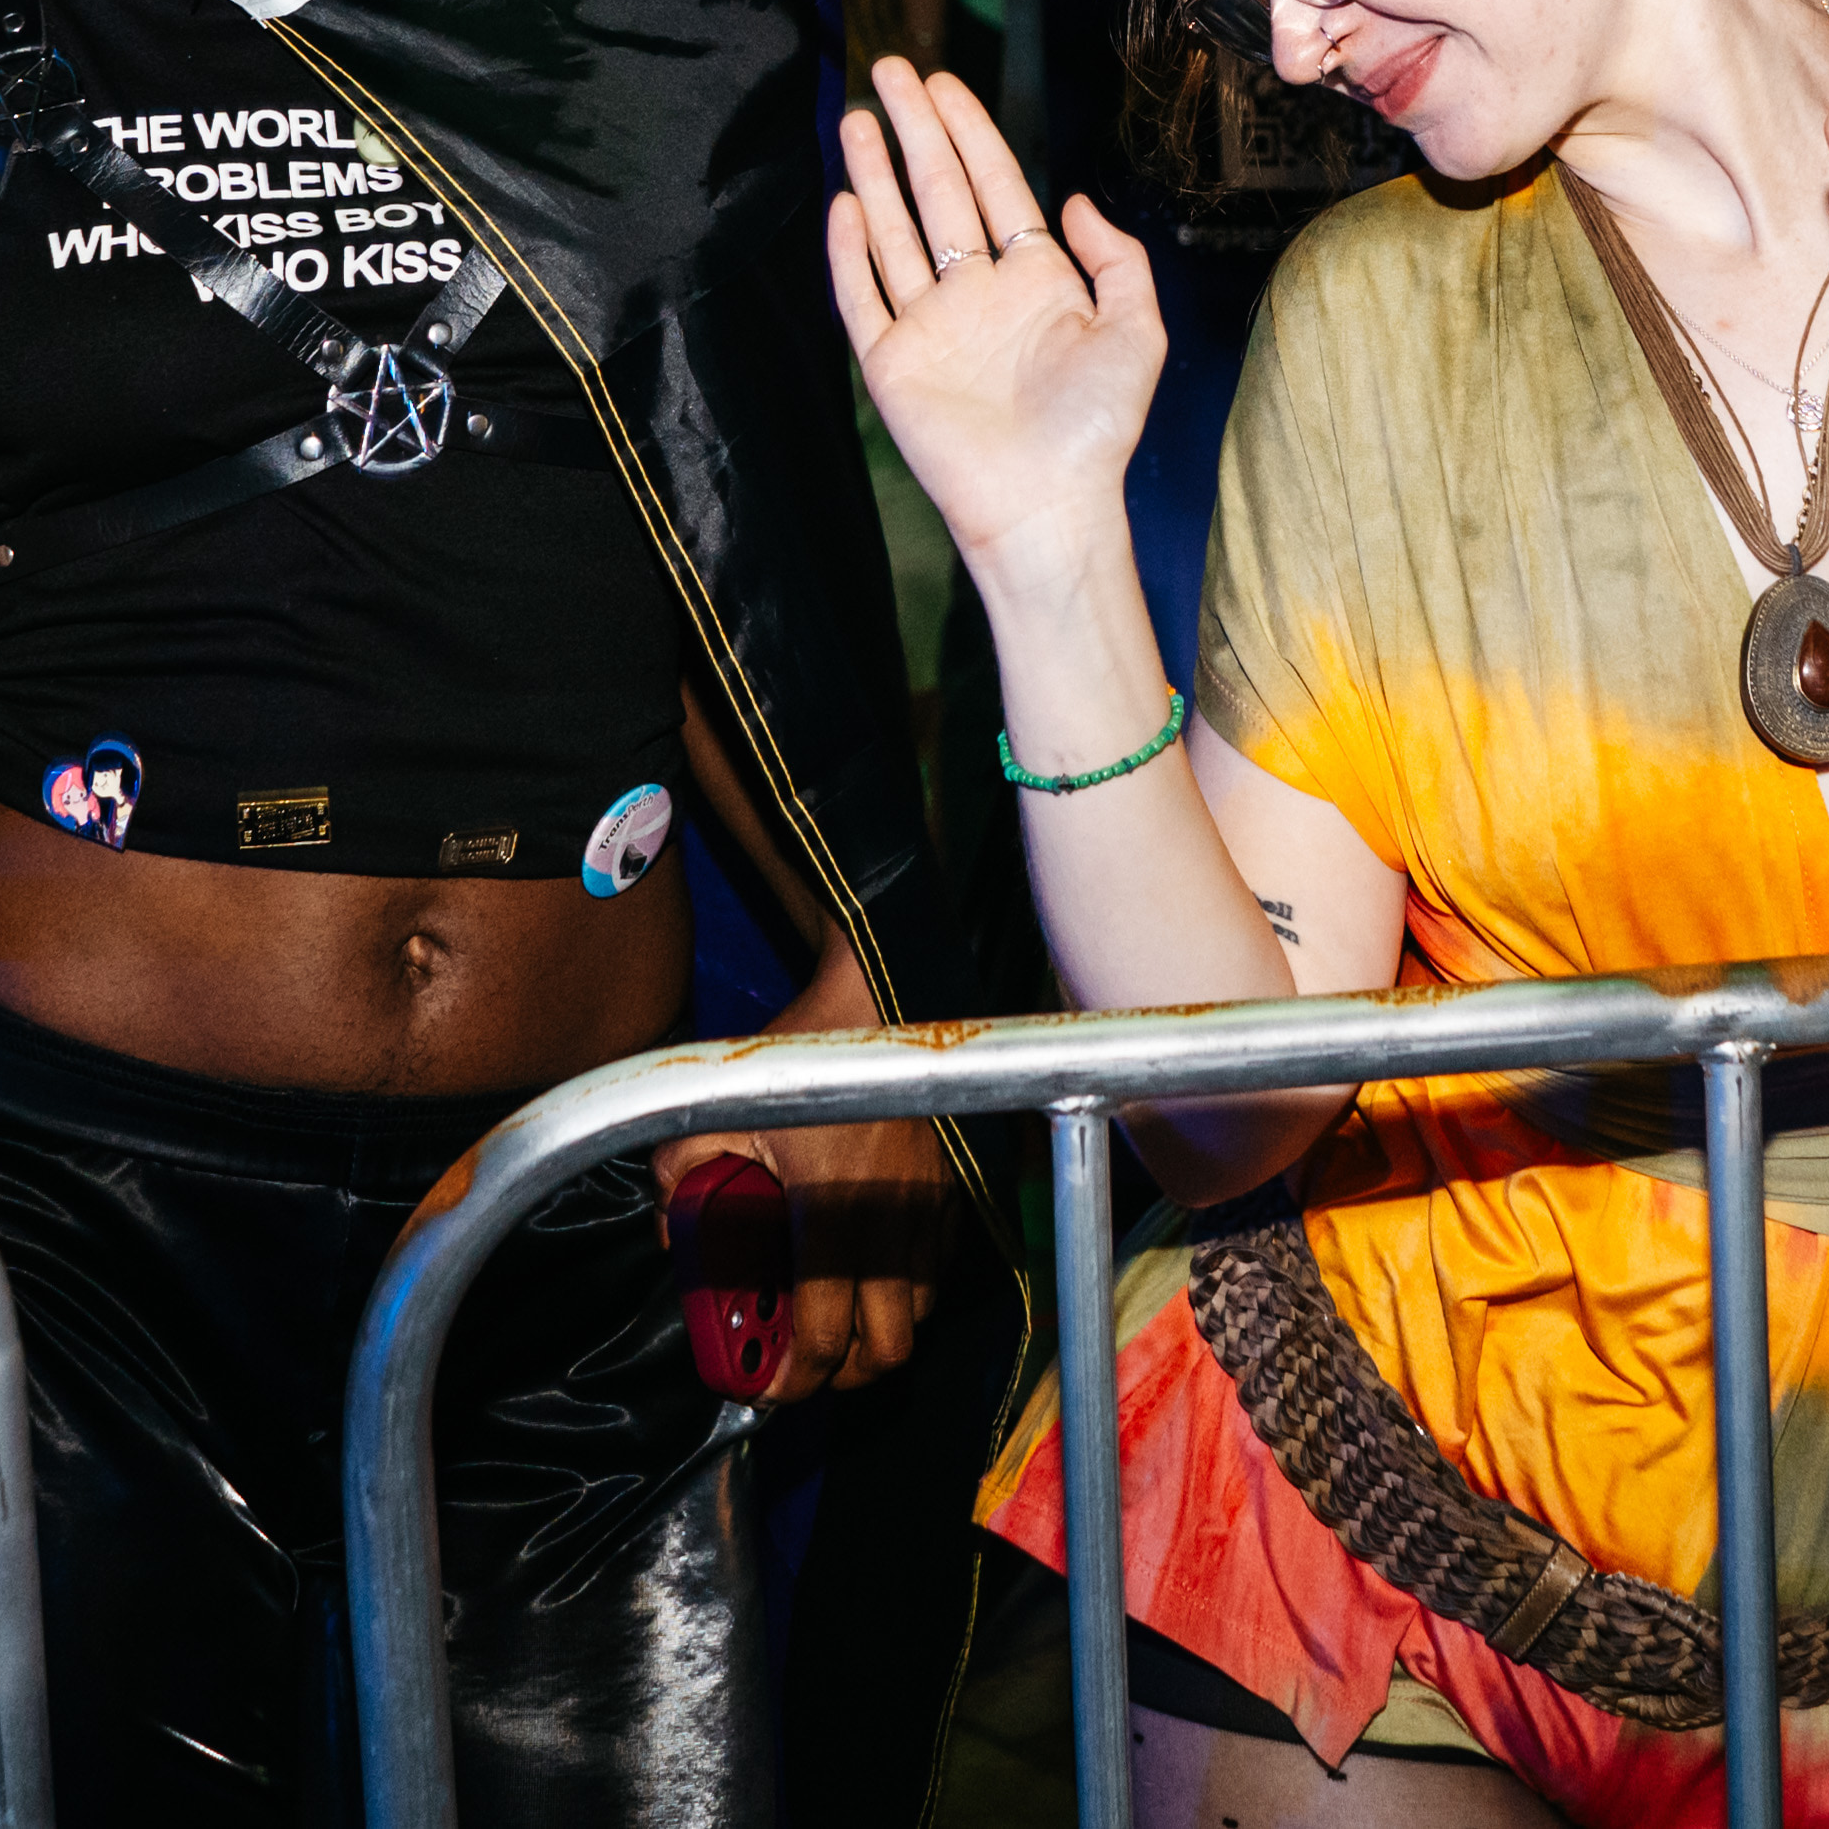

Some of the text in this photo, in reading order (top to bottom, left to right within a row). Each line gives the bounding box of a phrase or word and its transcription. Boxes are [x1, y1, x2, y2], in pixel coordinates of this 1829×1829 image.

[192, 108, 358, 150] WORL
[102, 160, 404, 208] ROBLEMS
[334, 201, 445, 234] BOY
[343, 238, 463, 289] KISS
